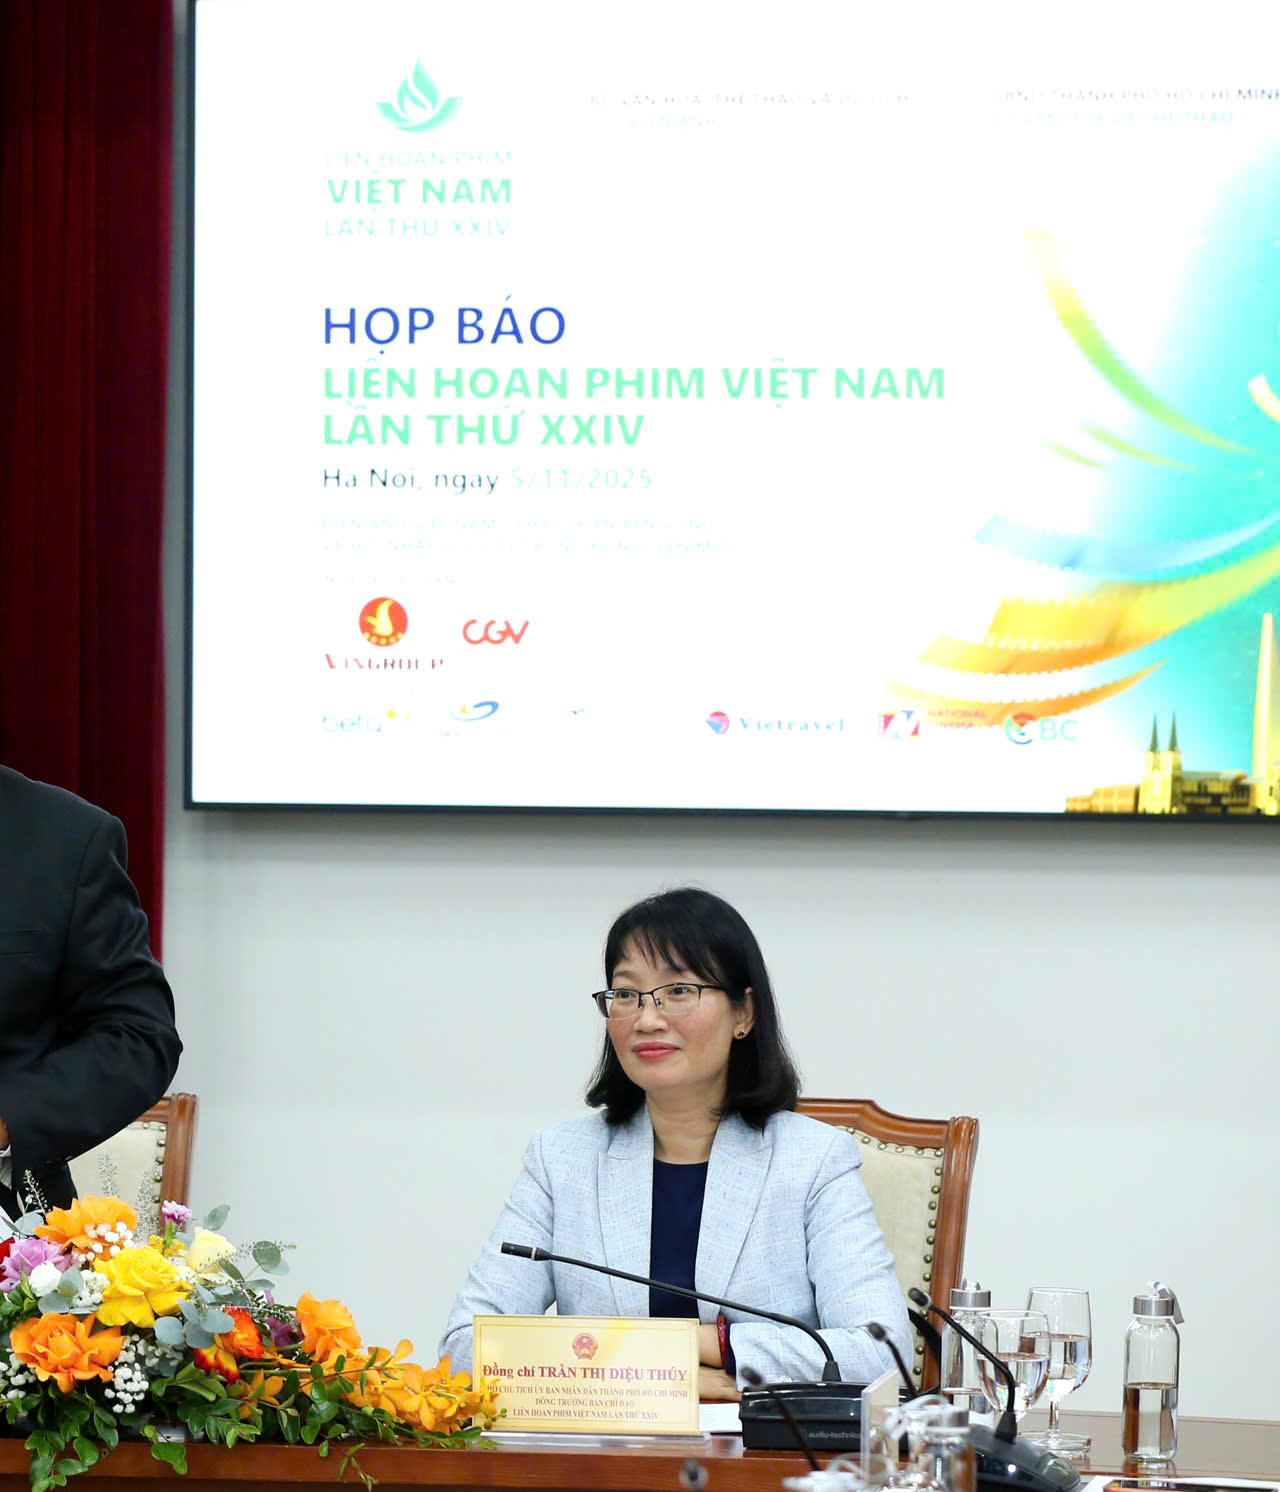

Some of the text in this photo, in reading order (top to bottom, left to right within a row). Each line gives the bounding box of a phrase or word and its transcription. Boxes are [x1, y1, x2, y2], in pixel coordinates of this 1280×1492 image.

[422, 178, 512, 205] NAM
[450, 217, 511, 238] XXIV
[325, 294, 566, 355] HỌP BÁO
[324, 358, 946, 408] LIÊN HOAN PHIM VIỆT NAM
[426, 406, 525, 445] THỨ
[540, 414, 645, 445] XXIV
[511, 467, 651, 489] 5/11/2025
[462, 619, 529, 645] CGV
[739, 716, 845, 733] Vietravel
[483, 1362, 688, 1382] Đồng chí TRẦN THỊ DIỆU THÚY
[545, 1386, 560, 1394] BAN
[668, 1389, 689, 1398] MINH
[531, 1408, 552, 1417] HOAN
[553, 1409, 572, 1417] PHIM
[591, 1410, 607, 1418] NAM
[589, 1399, 605, 1407] BAN
